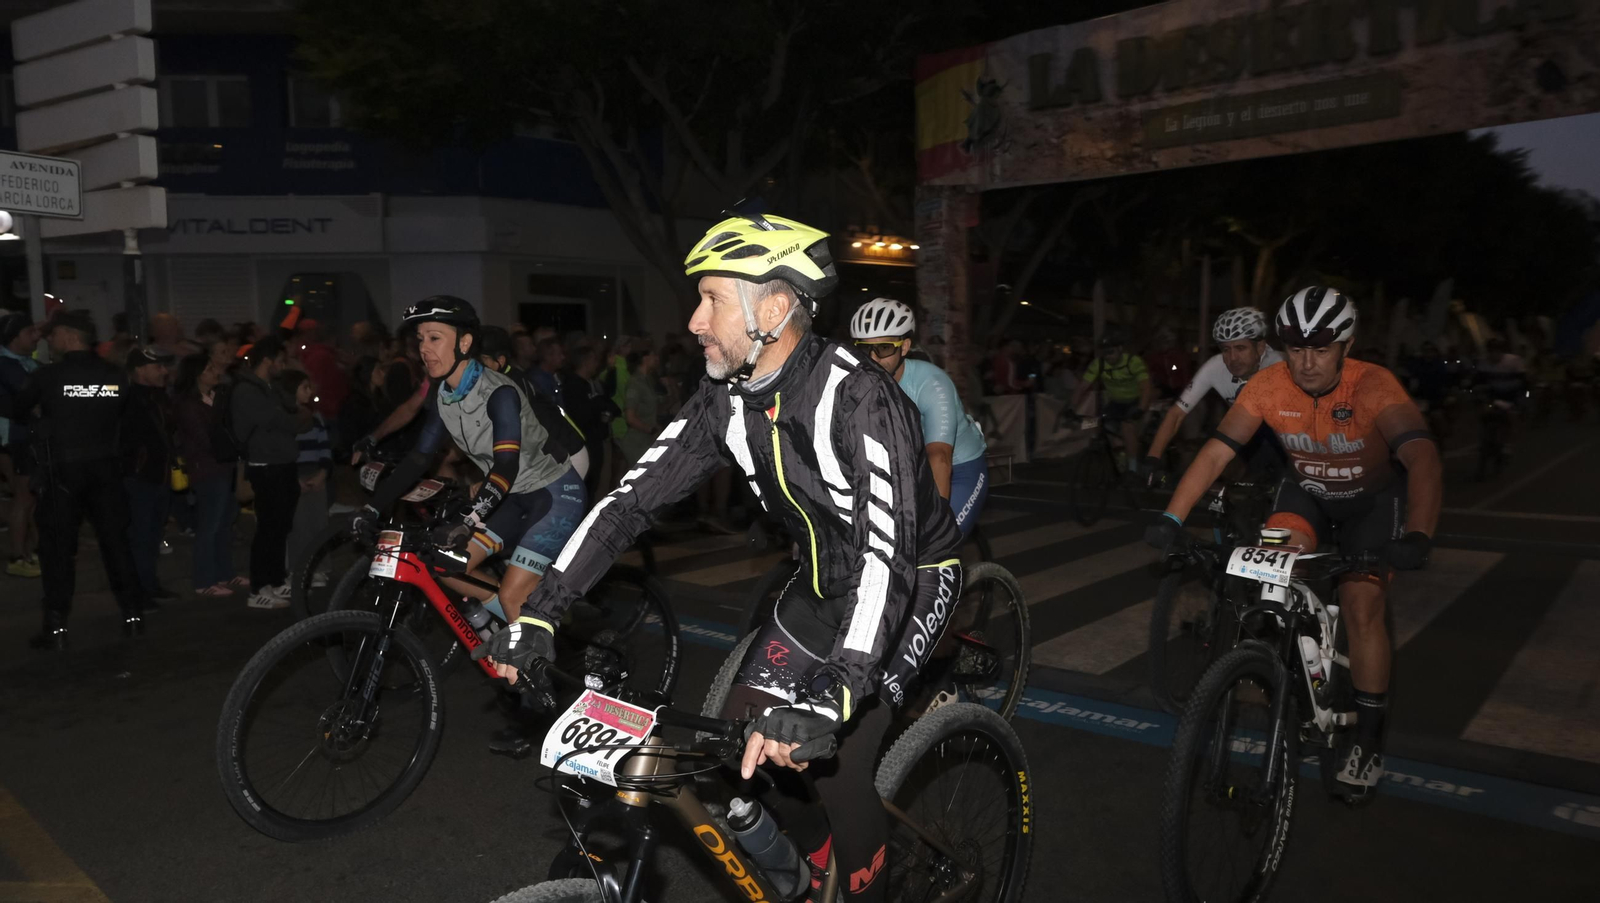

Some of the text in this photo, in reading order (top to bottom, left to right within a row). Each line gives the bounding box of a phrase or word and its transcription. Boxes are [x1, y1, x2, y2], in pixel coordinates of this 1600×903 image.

[1164, 117, 1178, 133] La
[1226, 112, 1235, 128] y
[1240, 106, 1251, 122] el
[1257, 100, 1307, 119] desierto
[1314, 96, 1337, 111] nos
[10, 161, 75, 177] AVENIDA
[1, 174, 60, 194] FEDERICO
[36, 195, 74, 211] LORCA
[168, 218, 333, 234] VITALDENT
[1278, 410, 1302, 418] FASTER
[1332, 439, 1365, 454] SPORT
[515, 554, 526, 565] LA
[1241, 547, 1291, 569] 8541
[1249, 568, 1278, 579] cajamar
[445, 603, 494, 669] cannonle
[561, 717, 633, 760] 6891
[565, 759, 599, 776] cajamar
[1017, 770, 1030, 834] MAXXIS
[693, 824, 770, 903] ORB
